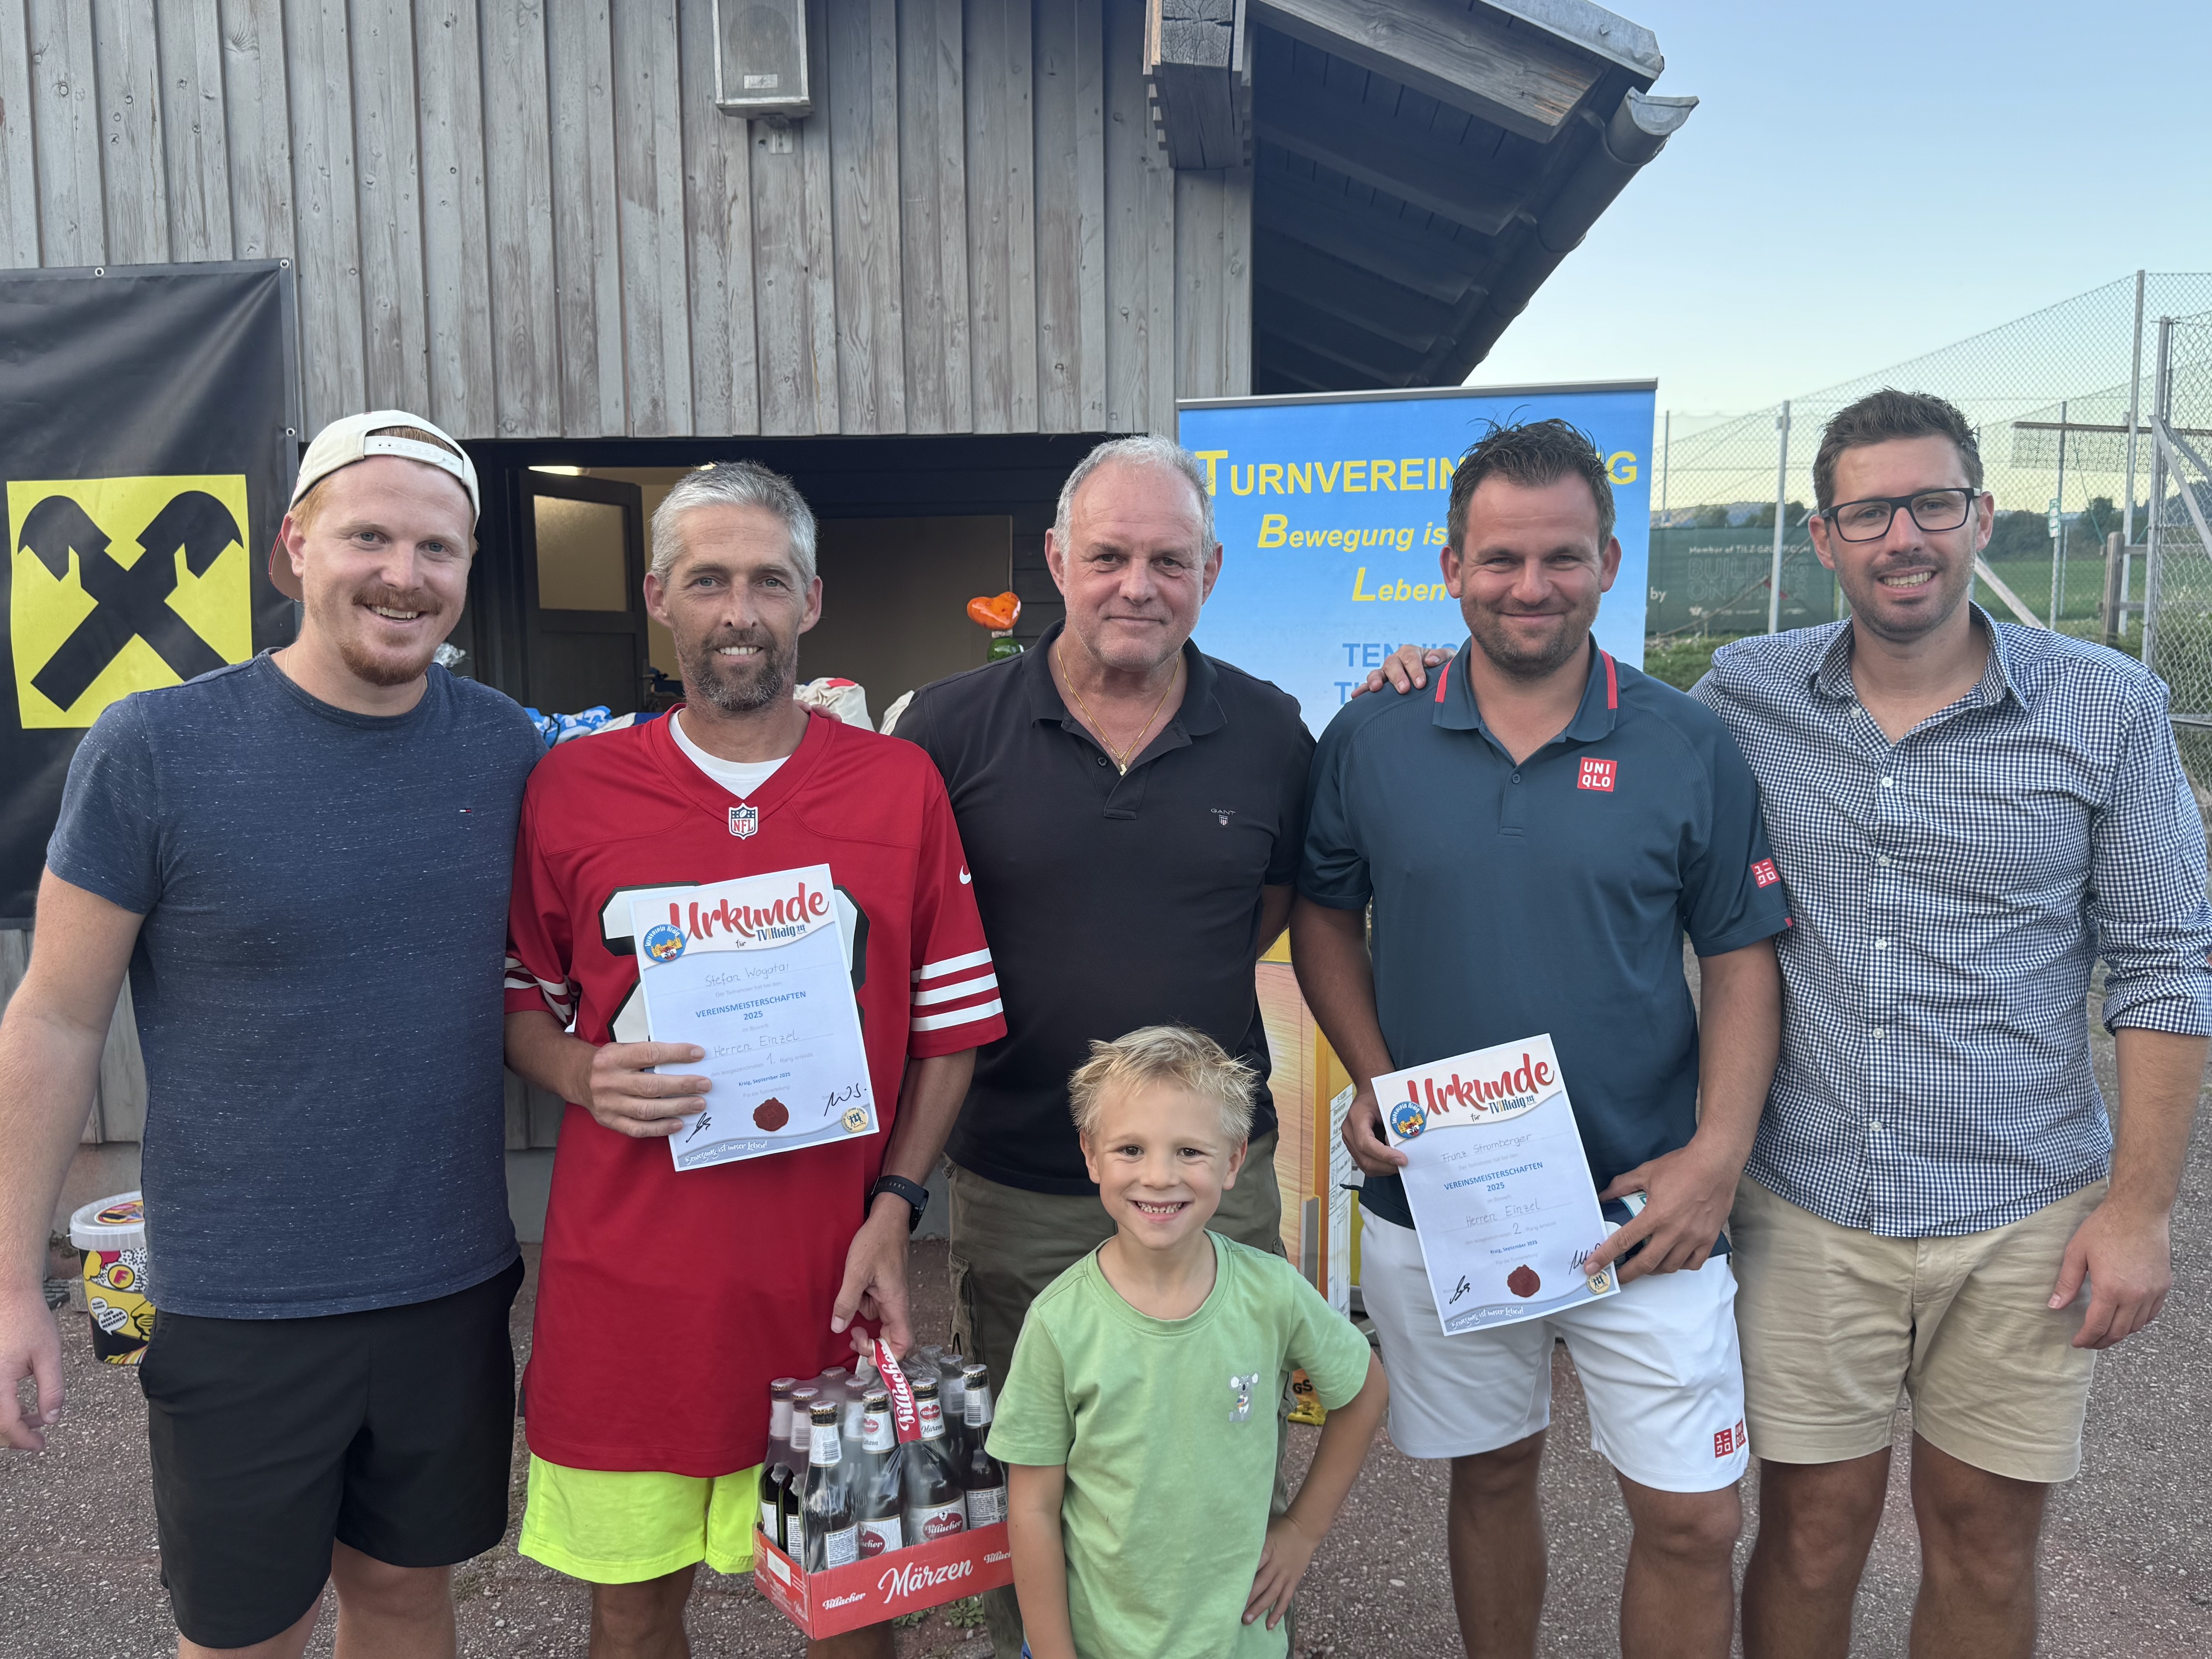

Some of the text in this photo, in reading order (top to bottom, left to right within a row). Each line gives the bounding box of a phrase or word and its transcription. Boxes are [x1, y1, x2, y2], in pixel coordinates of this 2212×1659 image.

[1257, 514, 1447, 552] Bewegung is
[1352, 567, 1446, 601] Leben
[1650, 586, 1666, 603] by
[1584, 761, 1610, 775] UNI
[1582, 774, 1611, 787] QLO
[733, 819, 753, 832] NFL
[670, 882, 829, 941] Urkunde
[706, 973, 740, 987] Stefan
[696, 991, 806, 1018] VEREINSMEISTERSCHAFTEN
[744, 1011, 763, 1020] 2025
[714, 1030, 799, 1057] Herren Einzel
[753, 1075, 778, 1084] September
[1407, 1053, 1554, 1118] Urkunde
[1441, 1134, 1532, 1163] Franz Stromberger
[1444, 1162, 1543, 1190] VEREINSMEISTERSCHAFTEN
[1487, 1182, 1505, 1192] 2025
[1466, 1198, 1541, 1227] Herren Einzel
[1503, 1243, 1526, 1252] September
[113, 1270, 129, 1285] F
[921, 1424, 943, 1434] Märzen
[925, 1520, 962, 1534] Villacher
[878, 1559, 973, 1604] Märzen
[823, 1592, 866, 1610] Villacher
